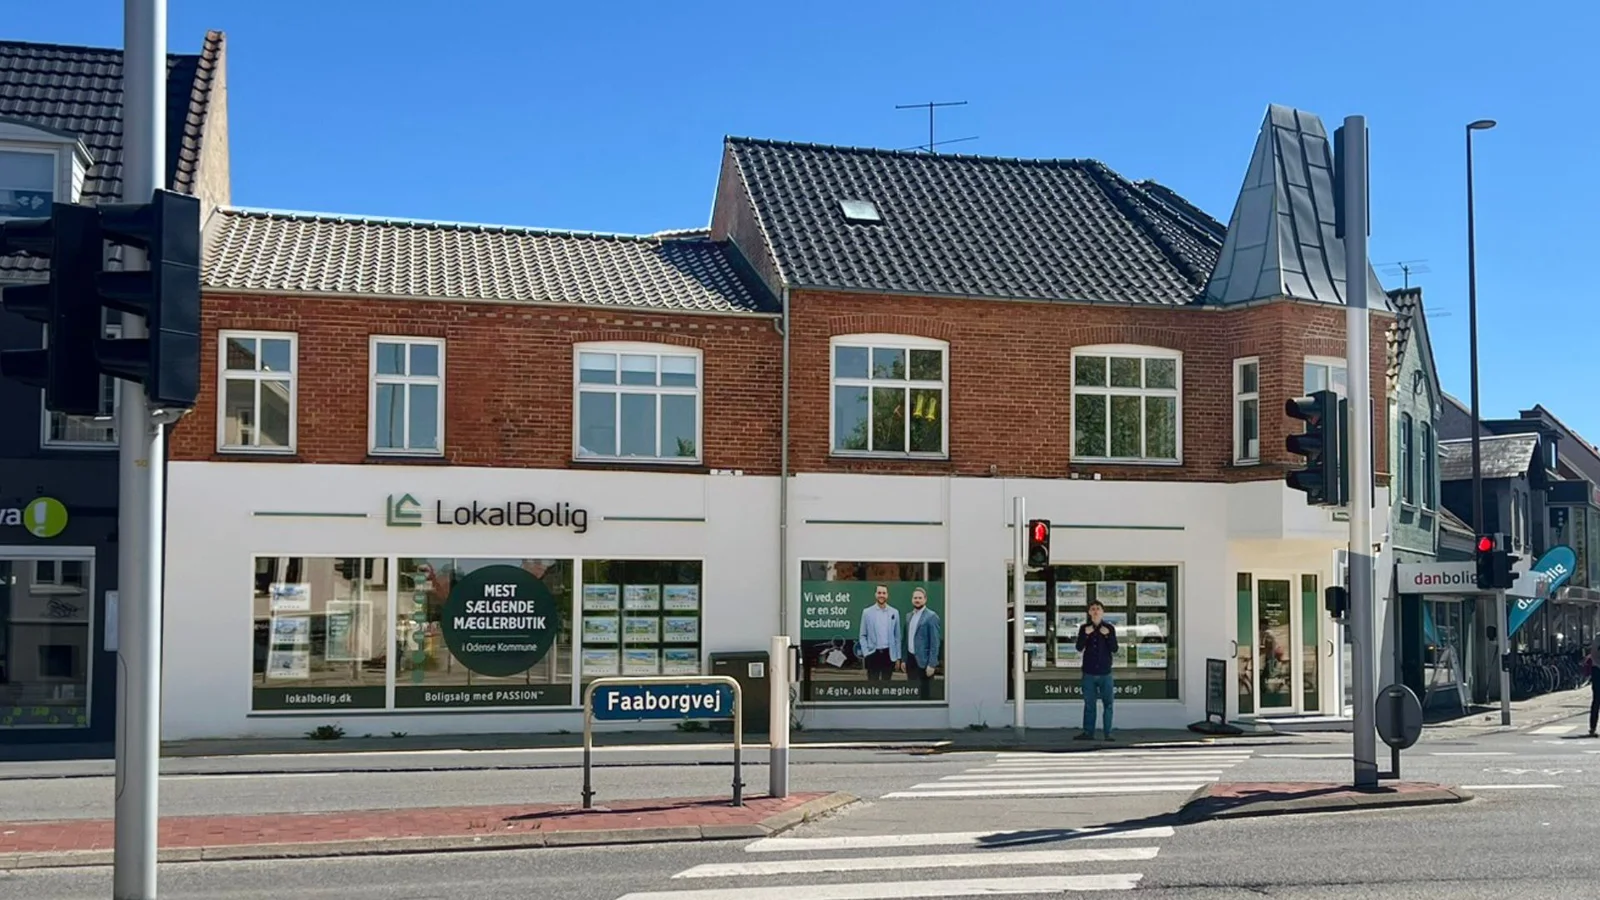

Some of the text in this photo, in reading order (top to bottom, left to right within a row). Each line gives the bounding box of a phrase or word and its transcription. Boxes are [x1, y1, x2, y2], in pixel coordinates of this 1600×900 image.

[436, 500, 588, 533] LokalBolig
[484, 584, 517, 597] MEST
[804, 591, 850, 604] Vi ved, det
[465, 600, 535, 614] SÆLGENDE
[806, 606, 847, 615] er en stor
[453, 616, 546, 630] MÆGLERBUTIK
[804, 618, 850, 630] beslutning
[466, 642, 496, 652] Odense
[497, 642, 538, 652] Kommune
[853, 686, 880, 695] lokale
[882, 687, 919, 697] mæglere
[1044, 685, 1062, 694] Skal
[1063, 686, 1072, 694] vi
[1124, 684, 1143, 695] dig?
[285, 693, 352, 705] lokalbolig.dk
[425, 692, 470, 703] Boligsalg
[472, 692, 494, 701] med
[607, 690, 721, 713] Faaborgvej
